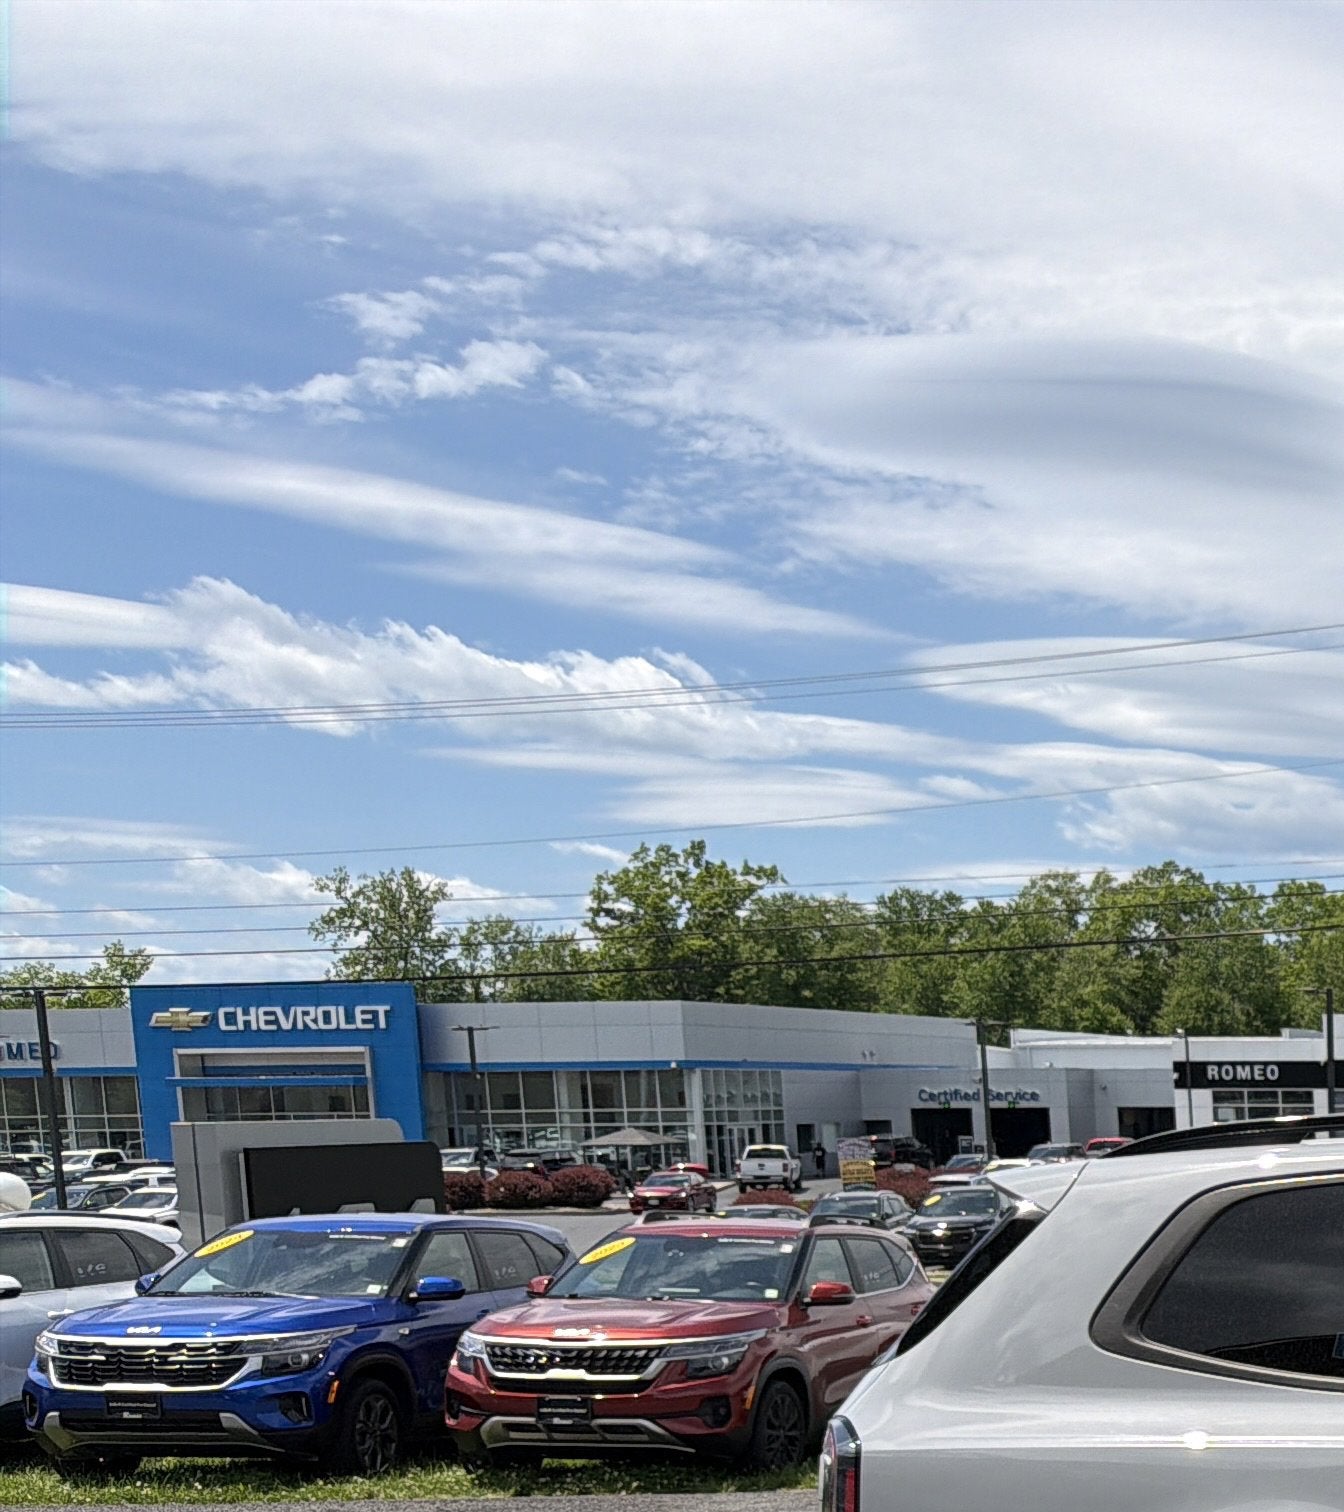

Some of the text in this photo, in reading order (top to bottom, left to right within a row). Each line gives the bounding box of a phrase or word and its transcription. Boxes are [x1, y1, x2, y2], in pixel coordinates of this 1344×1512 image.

[218, 1005, 390, 1031] CHEVROLET
[0, 1041, 60, 1060] MEO
[1206, 1064, 1279, 1081] ROMEO
[918, 1088, 1040, 1101] Certified Service
